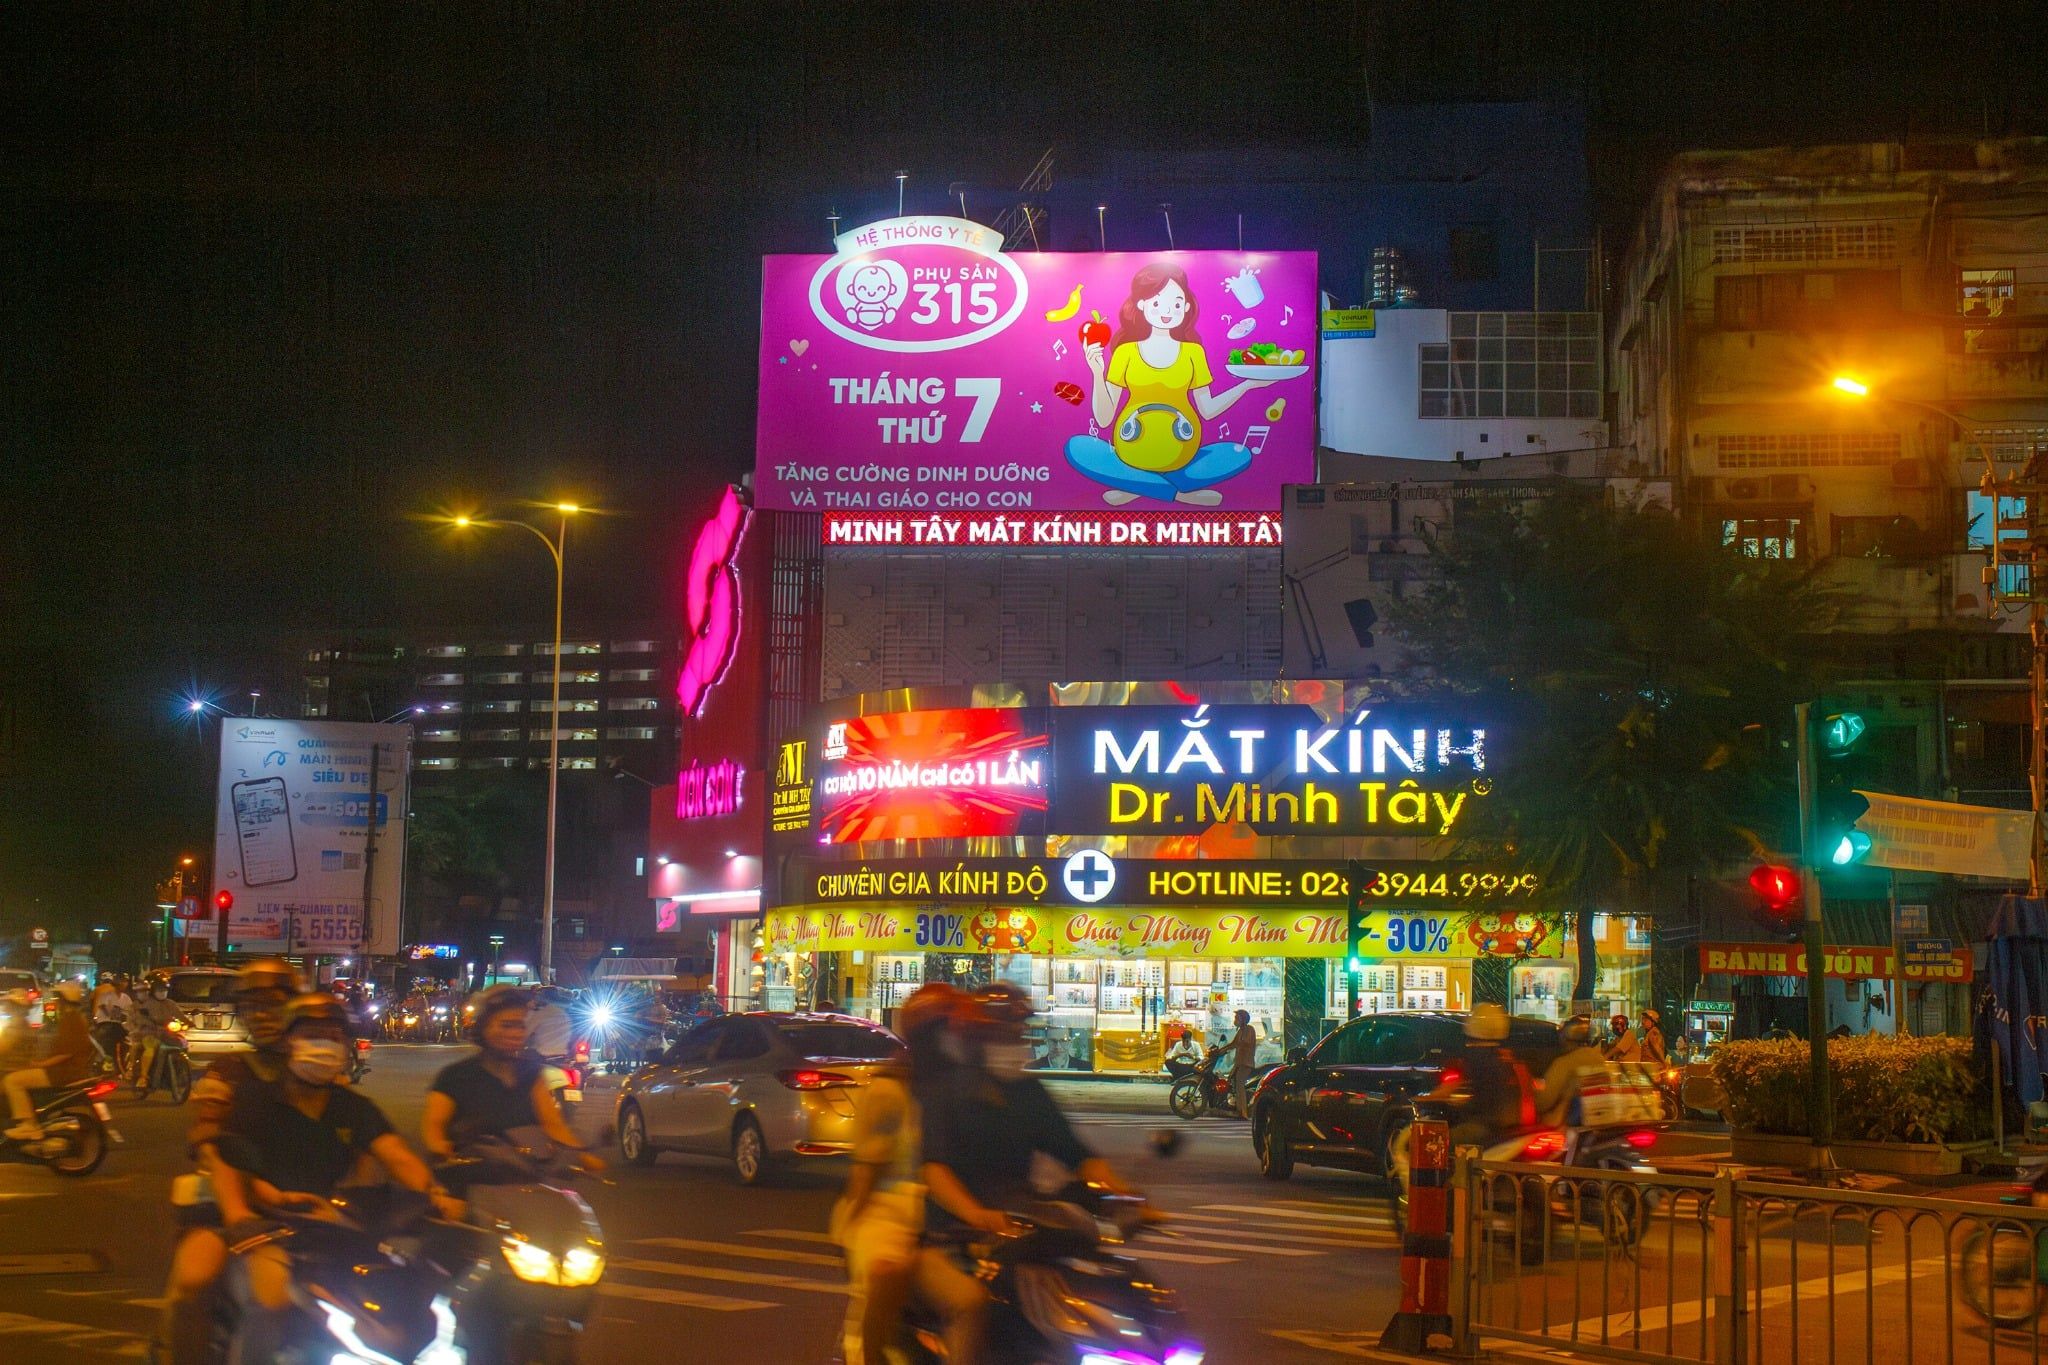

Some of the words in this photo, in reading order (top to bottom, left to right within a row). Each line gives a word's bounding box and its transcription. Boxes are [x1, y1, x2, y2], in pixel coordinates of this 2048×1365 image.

[857, 228, 878, 248] HỆ
[883, 220, 942, 240] THỐNG
[949, 226, 959, 241] Y
[963, 226, 984, 246] TẾ
[914, 267, 951, 284] PHỤ
[960, 263, 997, 280] SẢN
[911, 282, 998, 324] 315
[829, 371, 945, 404] THÁNG
[955, 378, 1001, 443] 7
[877, 410, 947, 444] THỨ
[775, 462, 829, 481] TĂNG
[835, 463, 910, 482] CƯỜNG
[917, 466, 967, 482] DINH
[974, 462, 1050, 482] DƯỠNG
[790, 487, 817, 506] VÀ
[824, 491, 870, 507] THAI
[877, 487, 929, 507] GIÁO
[935, 491, 980, 507] CHO
[987, 491, 1032, 507] CON
[829, 520, 902, 542] MINH
[910, 515, 962, 542] TÂY
[968, 515, 1025, 542] MẮT
[1033, 515, 1101, 542] KÍNH
[1110, 522, 1148, 542] DR
[1156, 522, 1230, 543] MINH
[1093, 704, 1265, 774] MẮT
[1295, 710, 1485, 774] KÍNH
[858, 766, 877, 790] 10
[878, 758, 919, 790] NĂM
[976, 761, 986, 785] 1
[1110, 782, 1184, 824] Dr.
[1196, 781, 1338, 824] Minh
[1359, 779, 1467, 836] Tây
[817, 866, 883, 897] CHUYÊN
[889, 871, 931, 896] GIA
[939, 862, 999, 895] KÍNH
[1007, 865, 1048, 901] ĐỘ
[1149, 871, 1292, 897] HOTLINE:
[823, 913, 855, 939] Năm
[858, 912, 898, 940] Mới
[1065, 912, 1123, 944] Chúc
[1128, 913, 1212, 953] Mừng
[1217, 914, 1288, 945] Năm
[1708, 946, 1787, 973] BÁNH
